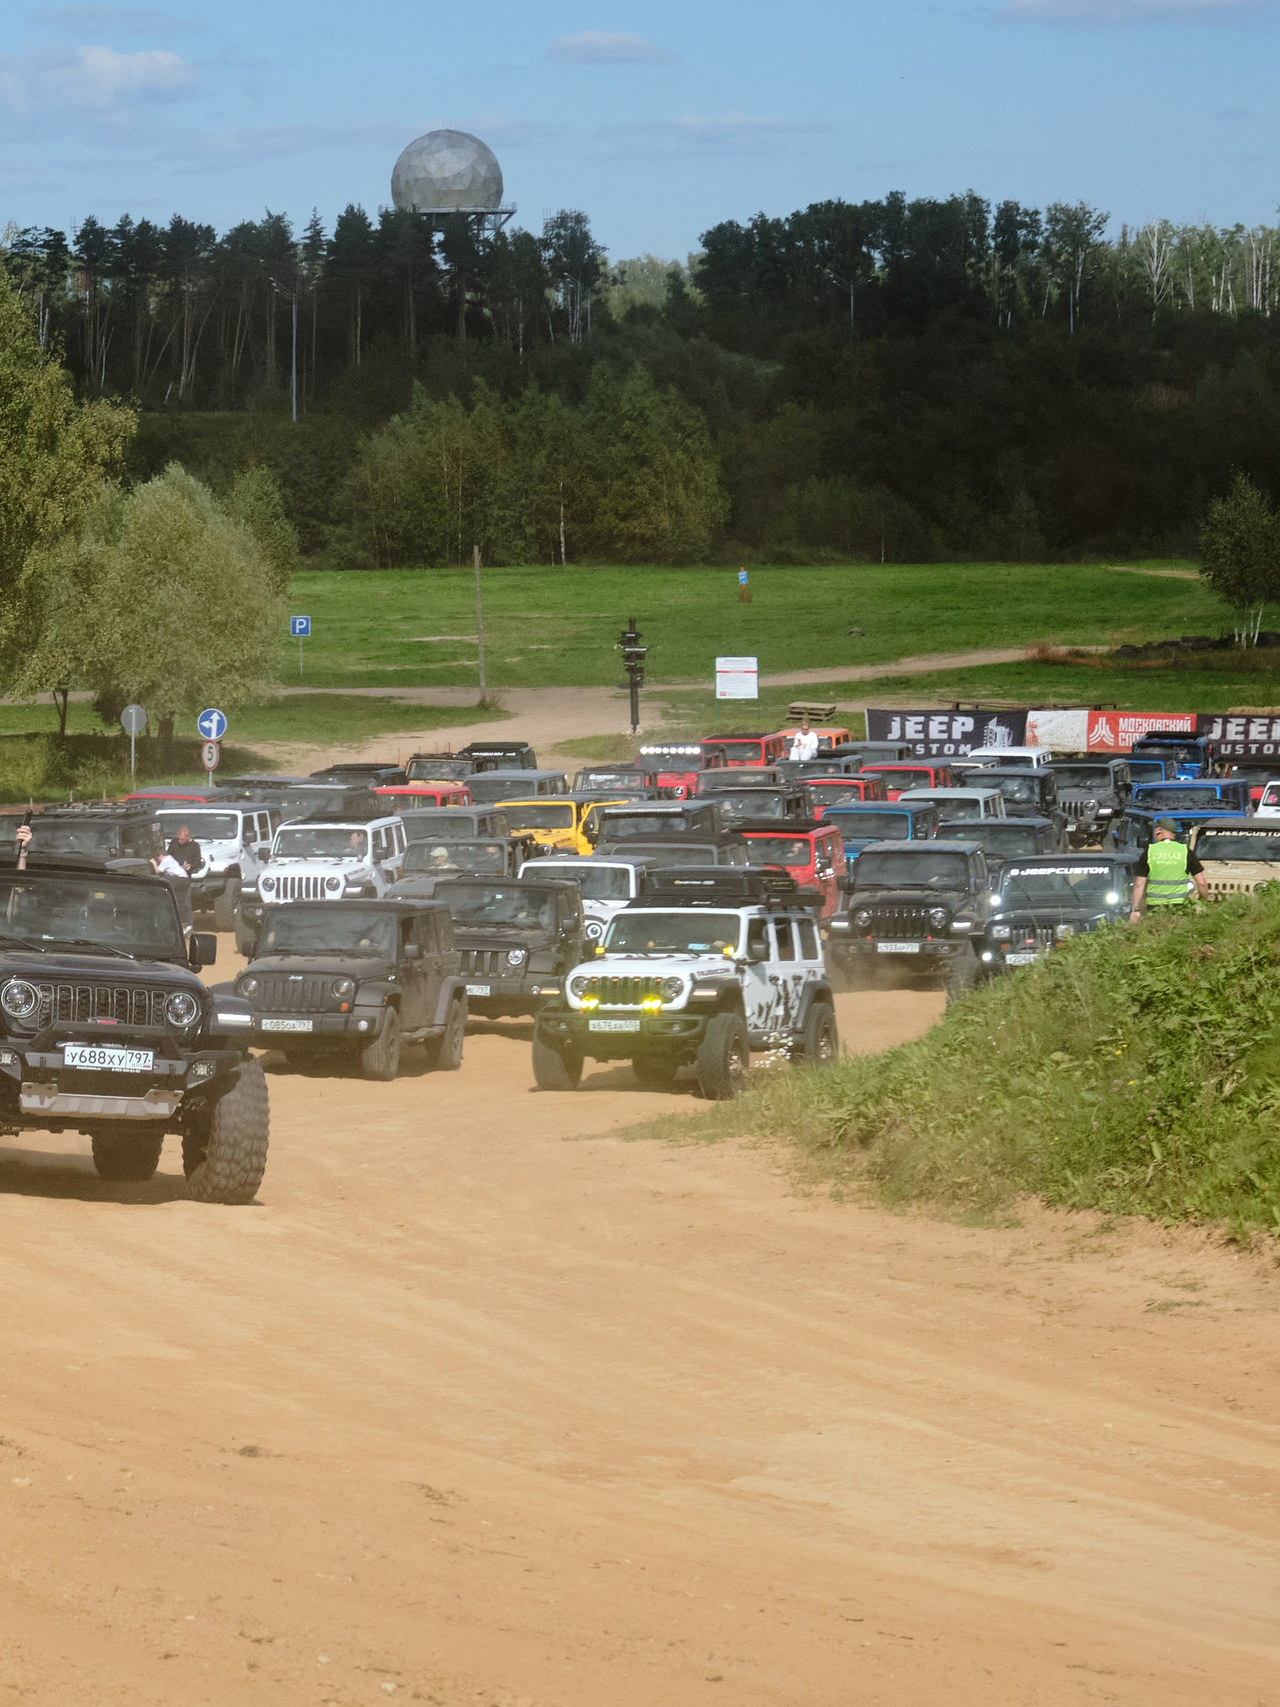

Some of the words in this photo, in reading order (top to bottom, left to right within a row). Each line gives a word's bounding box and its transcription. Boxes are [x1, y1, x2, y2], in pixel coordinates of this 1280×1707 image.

[295, 618, 307, 634] P
[887, 715, 975, 740] JEEP
[1118, 716, 1192, 733] МОСКОВСКИЙ
[207, 745, 214, 762] 5
[908, 743, 972, 755] STOM
[1220, 743, 1280, 755] USTO
[128, 1052, 149, 1064] 797
